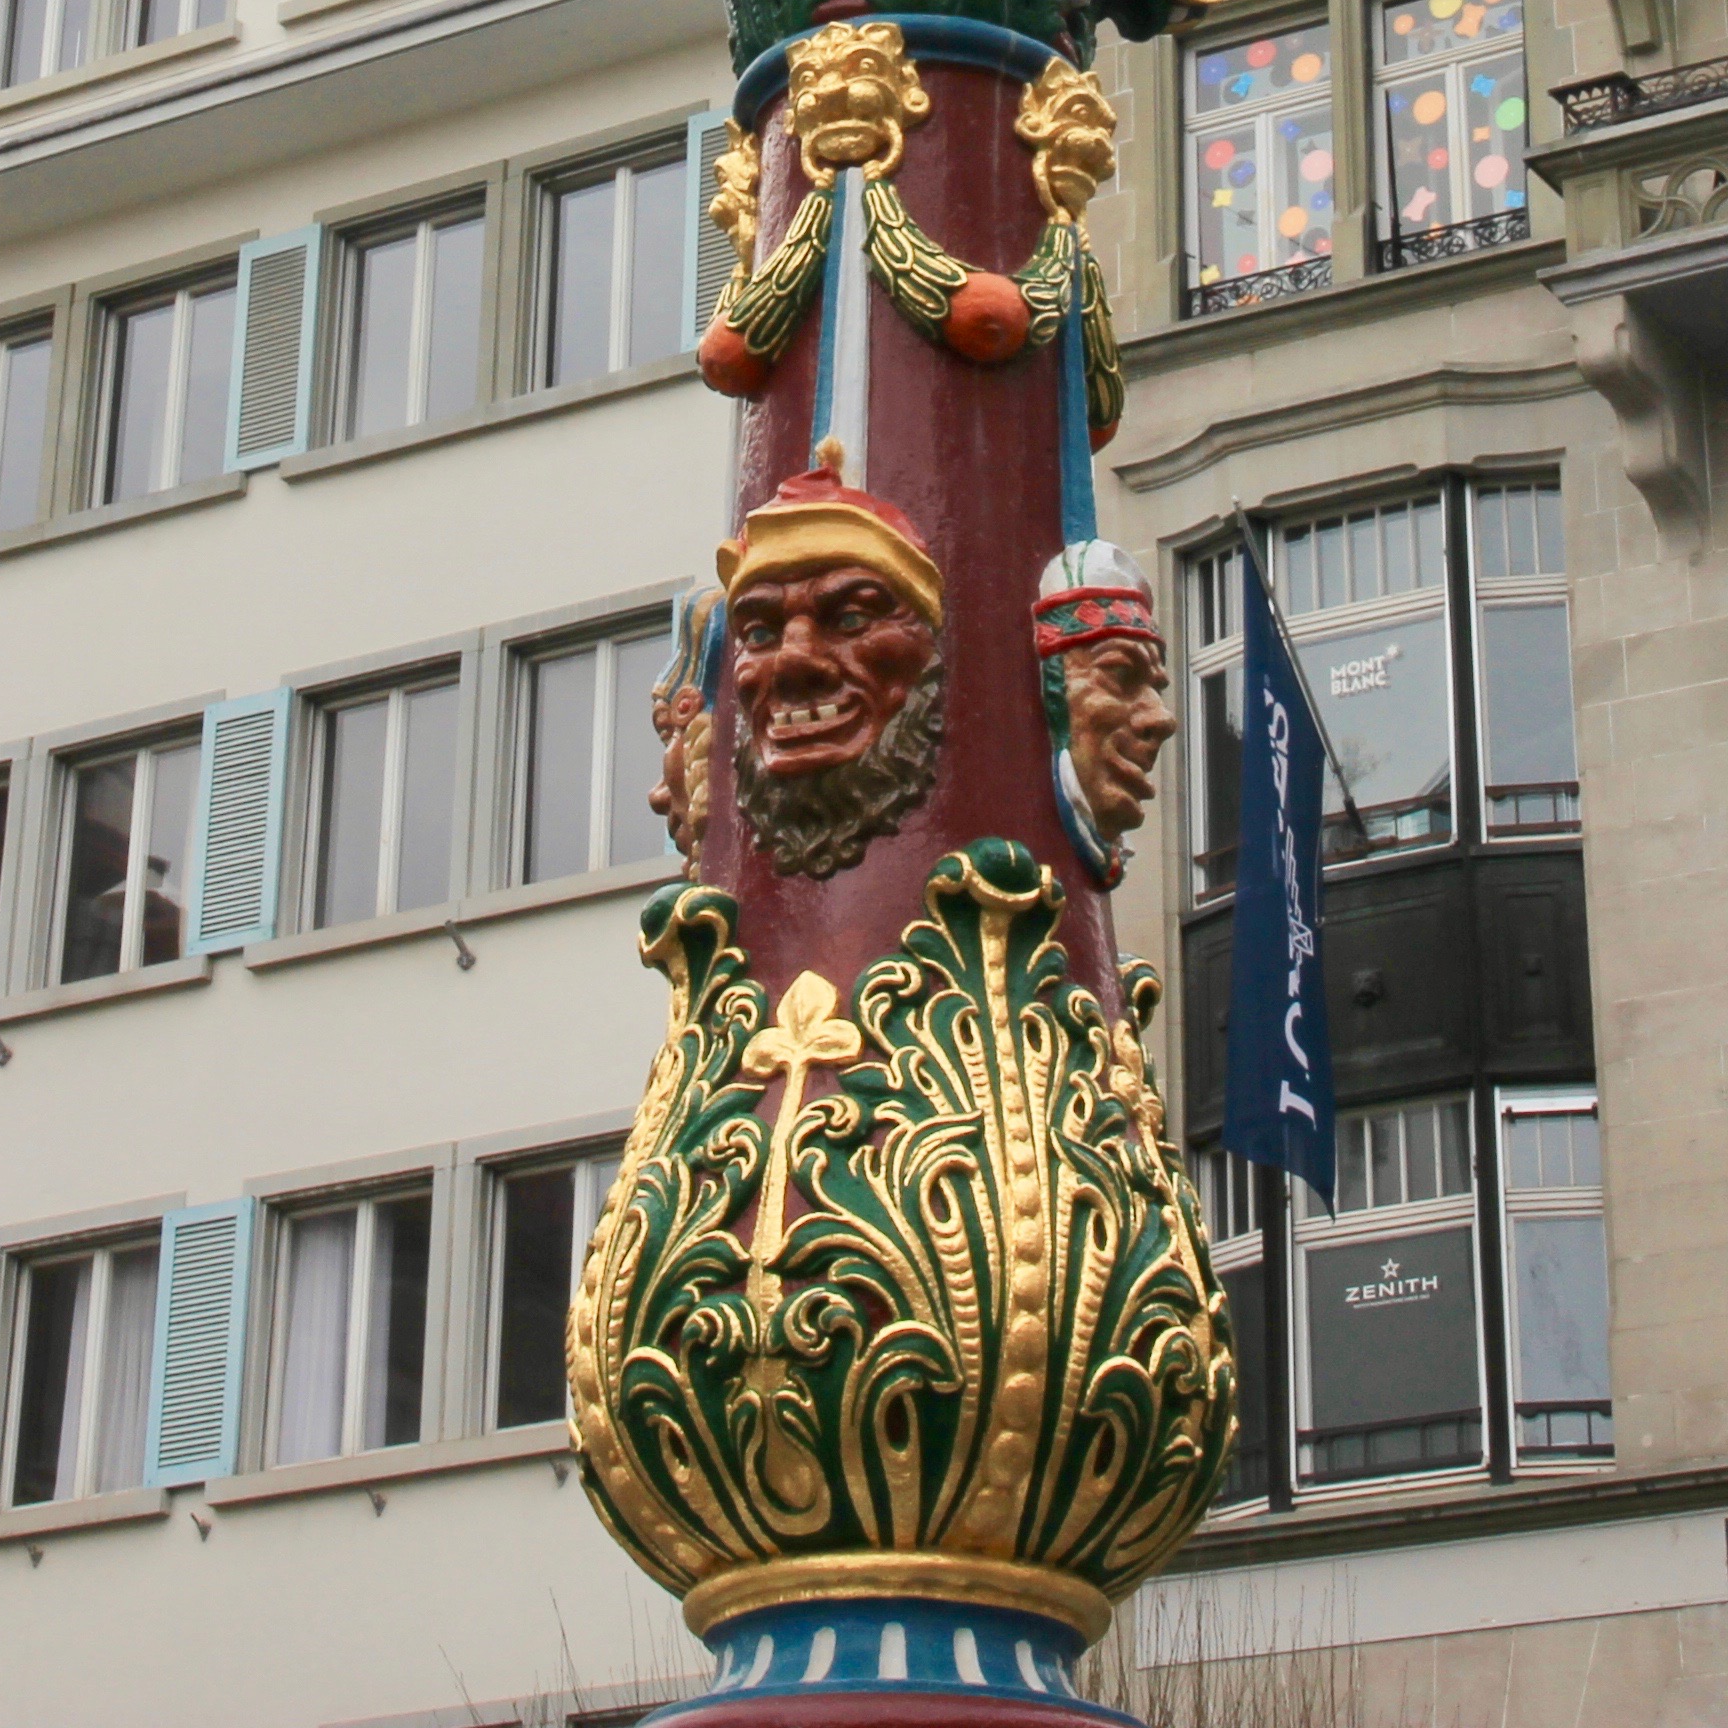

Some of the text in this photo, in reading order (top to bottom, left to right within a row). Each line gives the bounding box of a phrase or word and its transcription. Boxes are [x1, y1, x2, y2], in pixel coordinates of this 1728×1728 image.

[1330, 655, 1386, 680] MONT
[1330, 670, 1387, 696] BLANC
[1344, 1275, 1438, 1303] ZENITH
